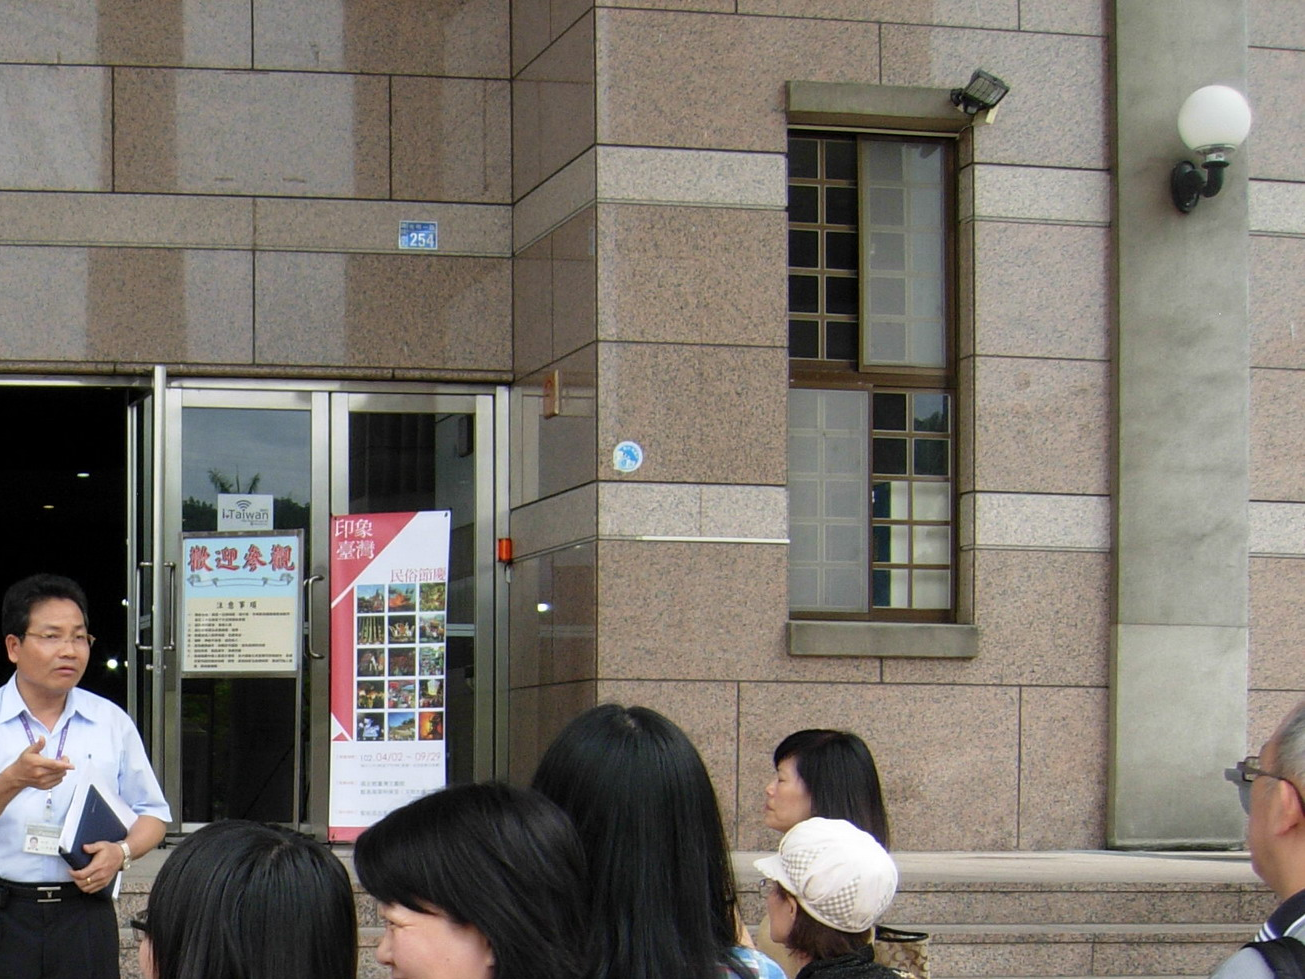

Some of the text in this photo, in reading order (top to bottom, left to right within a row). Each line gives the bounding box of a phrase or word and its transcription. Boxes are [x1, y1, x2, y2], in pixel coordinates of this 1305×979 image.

[410, 232, 435, 247] 254
[335, 518, 374, 538] 印象
[187, 543, 295, 572] 歡迎參觀
[336, 540, 376, 560] 臺灣
